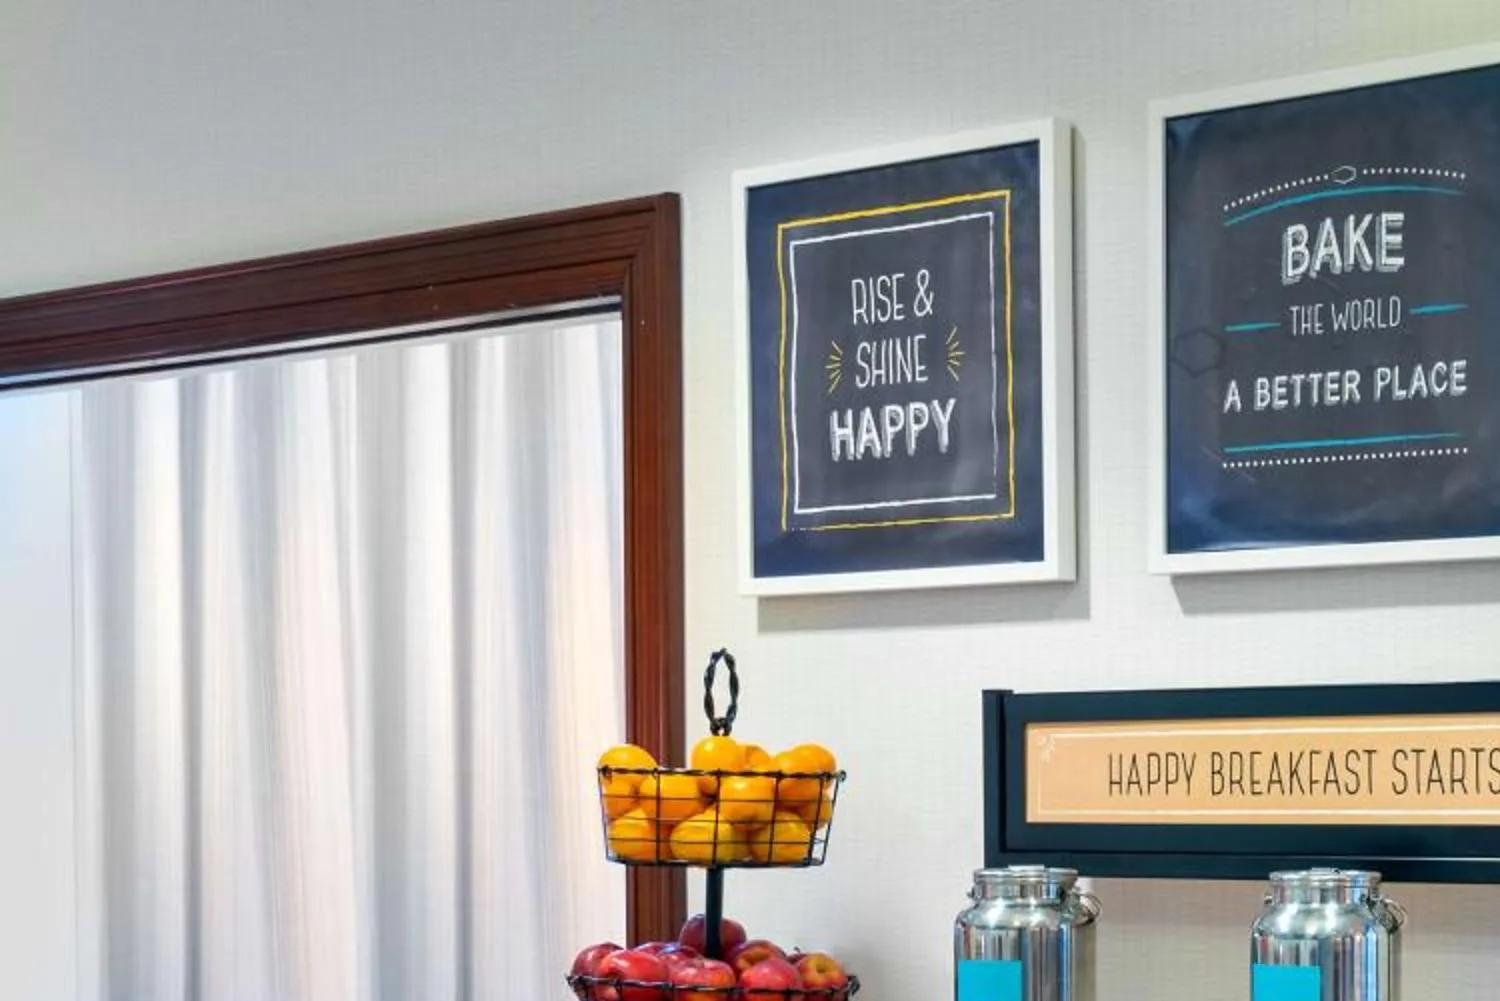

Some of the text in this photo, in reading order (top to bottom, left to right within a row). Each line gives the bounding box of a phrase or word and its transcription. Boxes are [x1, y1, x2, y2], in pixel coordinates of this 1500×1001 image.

[1281, 212, 1405, 285] BAKE
[851, 269, 934, 325] RISE &
[1289, 295, 1401, 337] THE WORLD
[854, 333, 929, 388] SHINE
[1223, 359, 1468, 413] A BETTER PLACE
[829, 398, 957, 462] HAPPY
[1108, 751, 1197, 797] HAPPY
[1210, 749, 1377, 797] BREAKFAST
